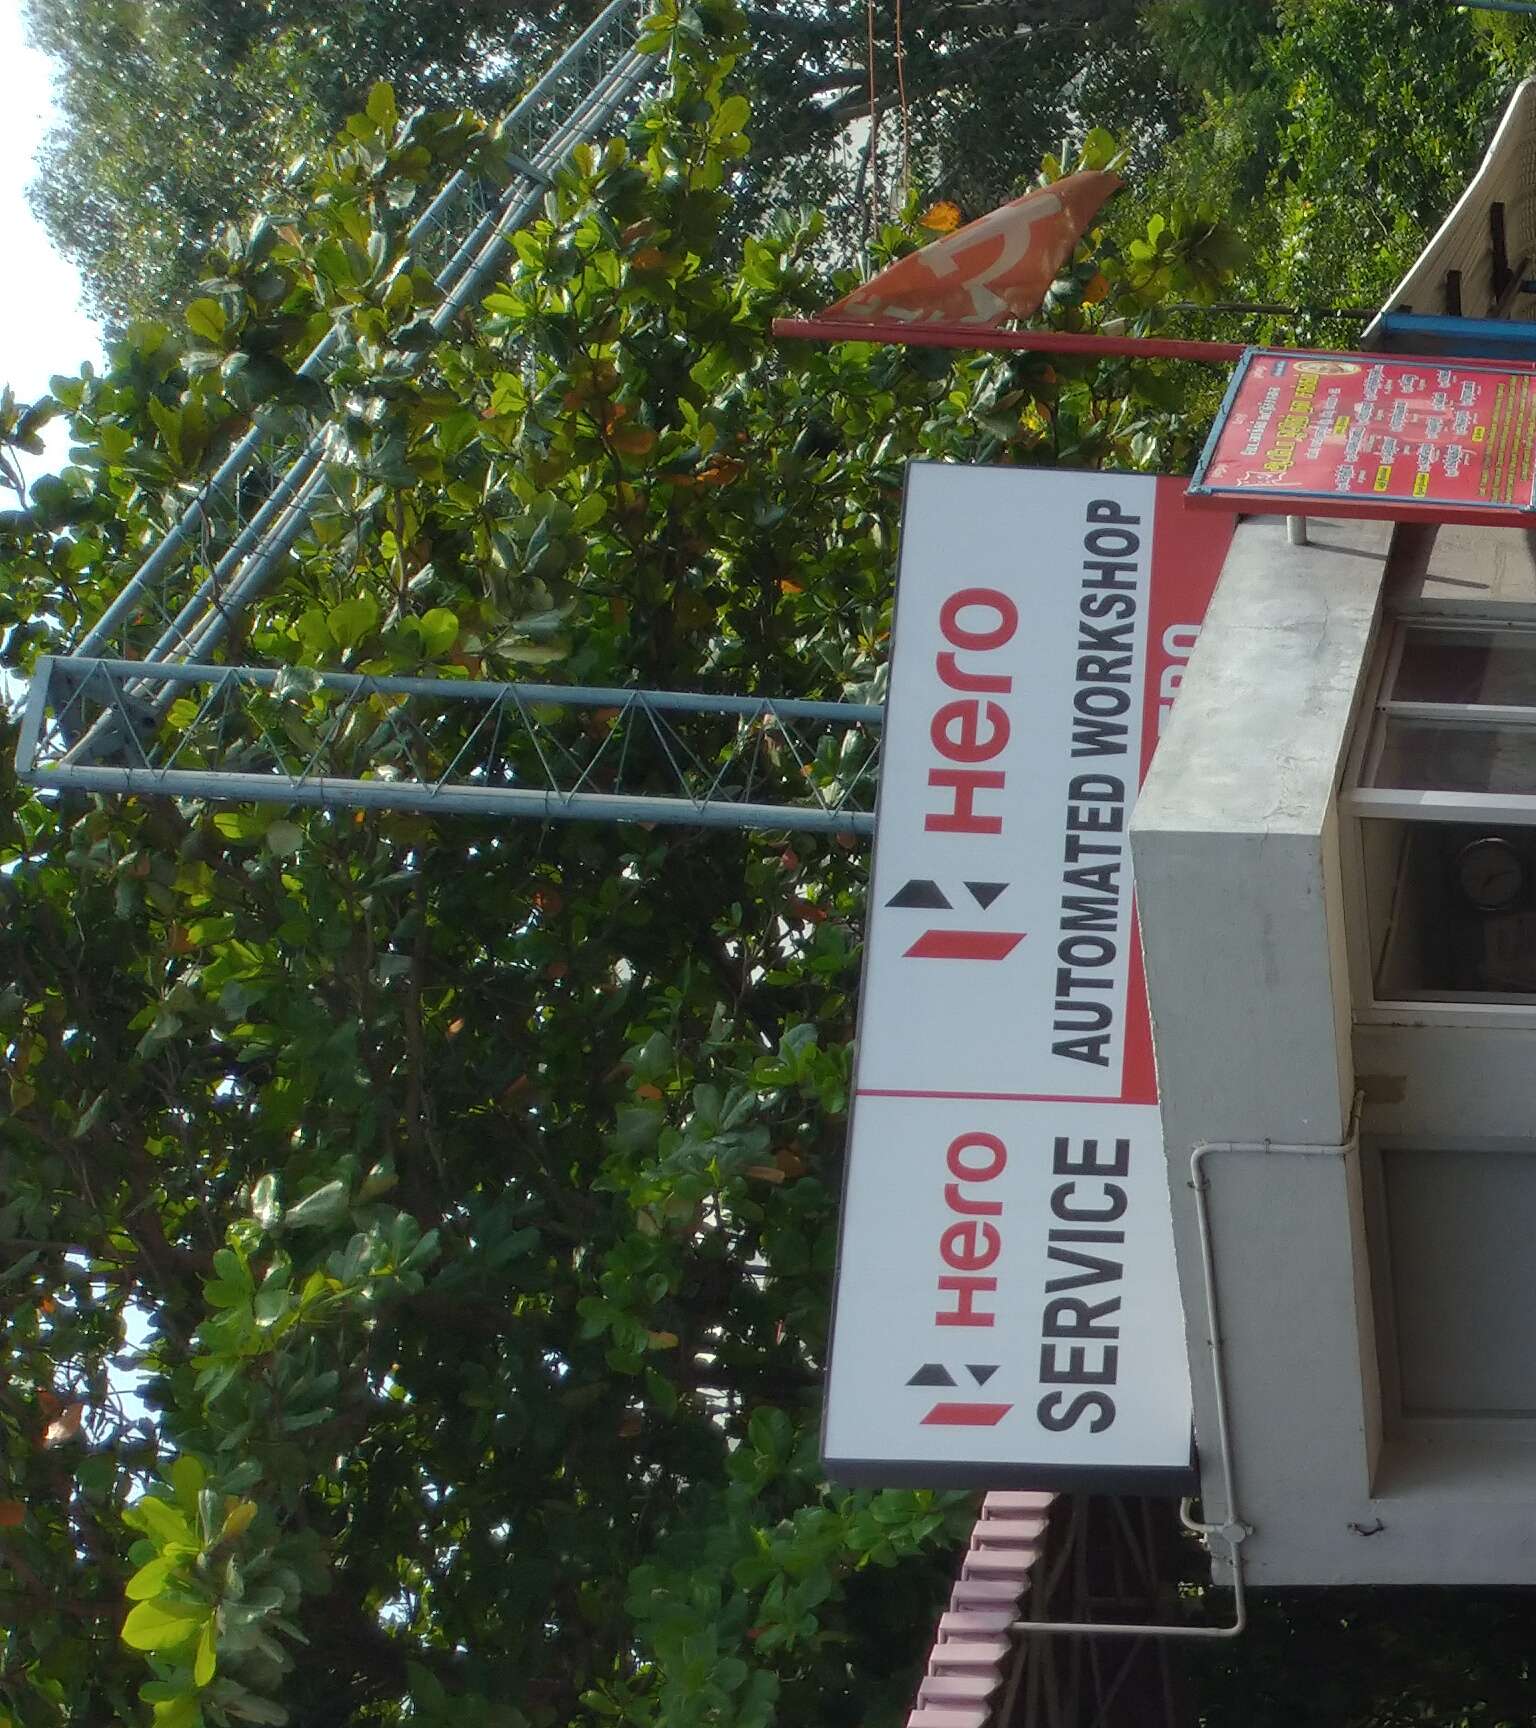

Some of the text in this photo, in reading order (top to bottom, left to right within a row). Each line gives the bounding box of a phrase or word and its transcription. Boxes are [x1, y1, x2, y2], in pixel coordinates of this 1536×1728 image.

[924, 588, 1018, 834] Hero
[1052, 500, 1141, 1067] AUTOMATED WORKSHOP
[935, 1132, 1007, 1326] Hero
[1037, 1137, 1130, 1434] SERVICE
